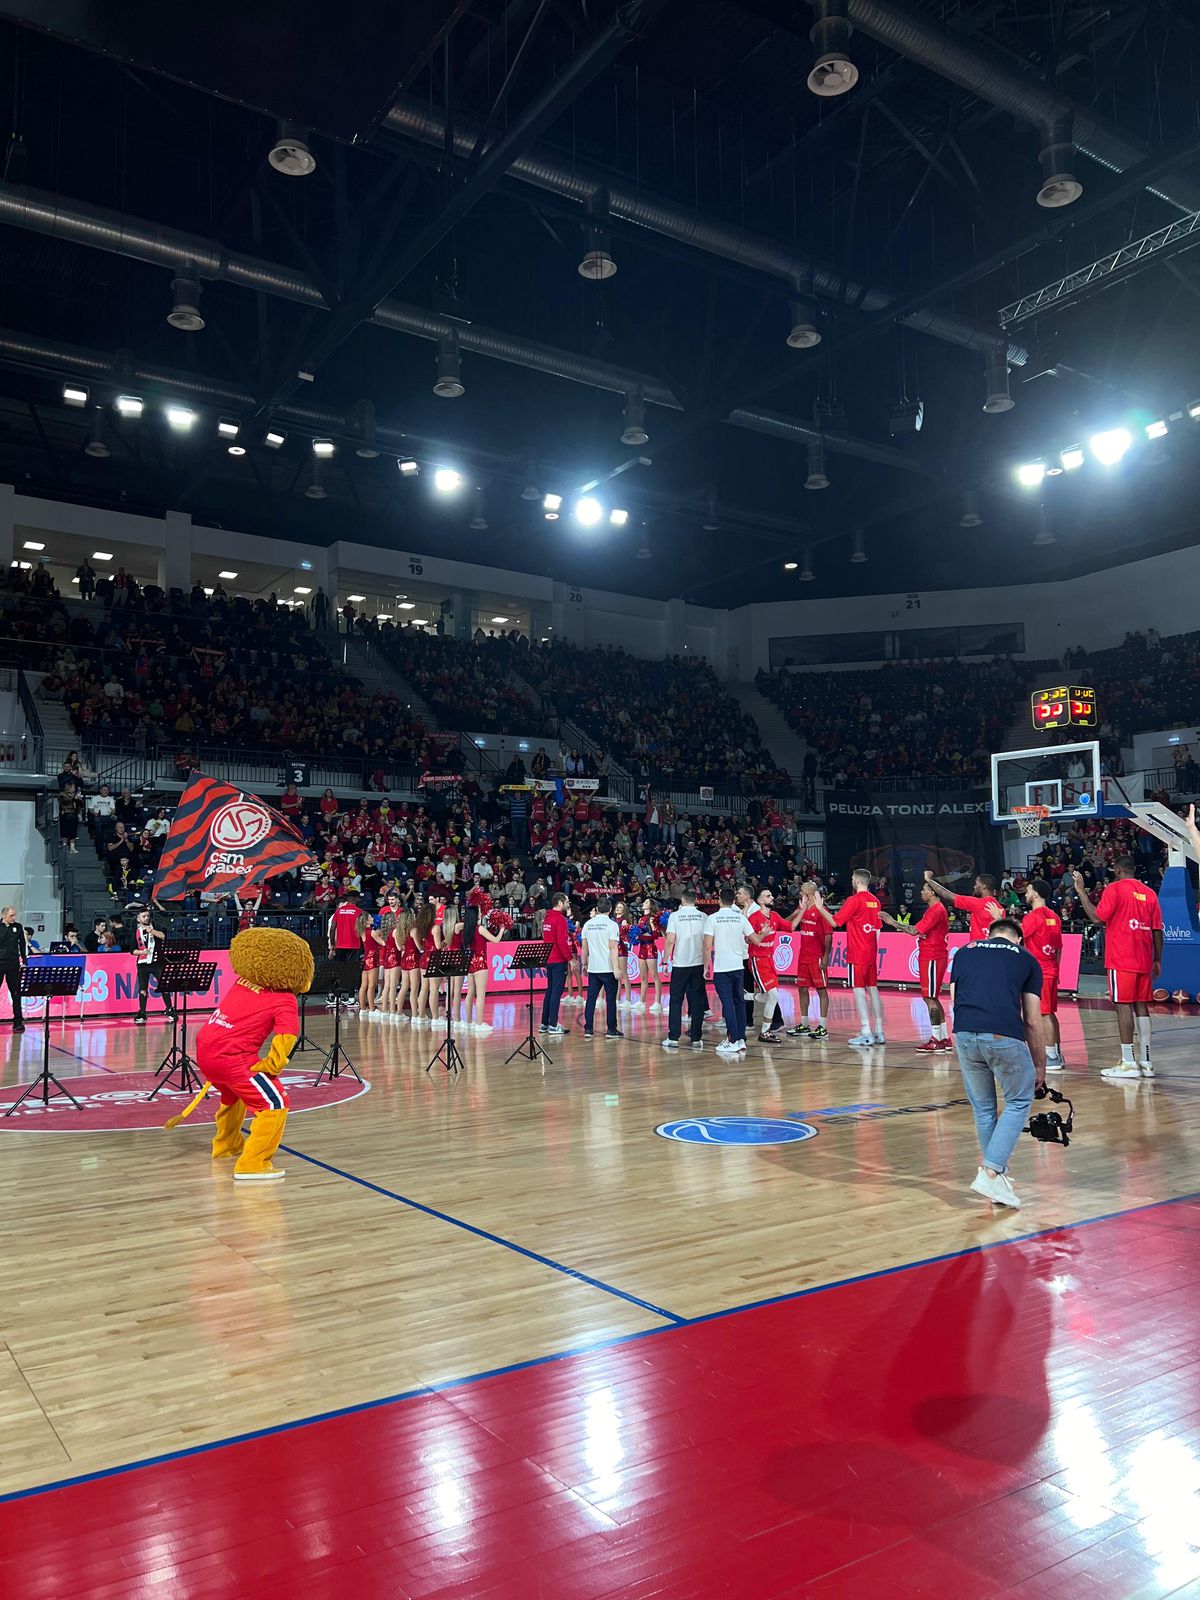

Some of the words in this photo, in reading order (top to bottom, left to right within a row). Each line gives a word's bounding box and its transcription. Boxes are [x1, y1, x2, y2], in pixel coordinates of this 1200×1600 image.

[408, 564, 424, 576] 19
[569, 592, 583, 604] 20
[906, 600, 921, 610] 21
[293, 769, 304, 783] 3
[829, 803, 883, 816] PELUZA
[886, 804, 935, 815] TONI
[977, 942, 1020, 954] MEDIA
[491, 954, 516, 982] 23
